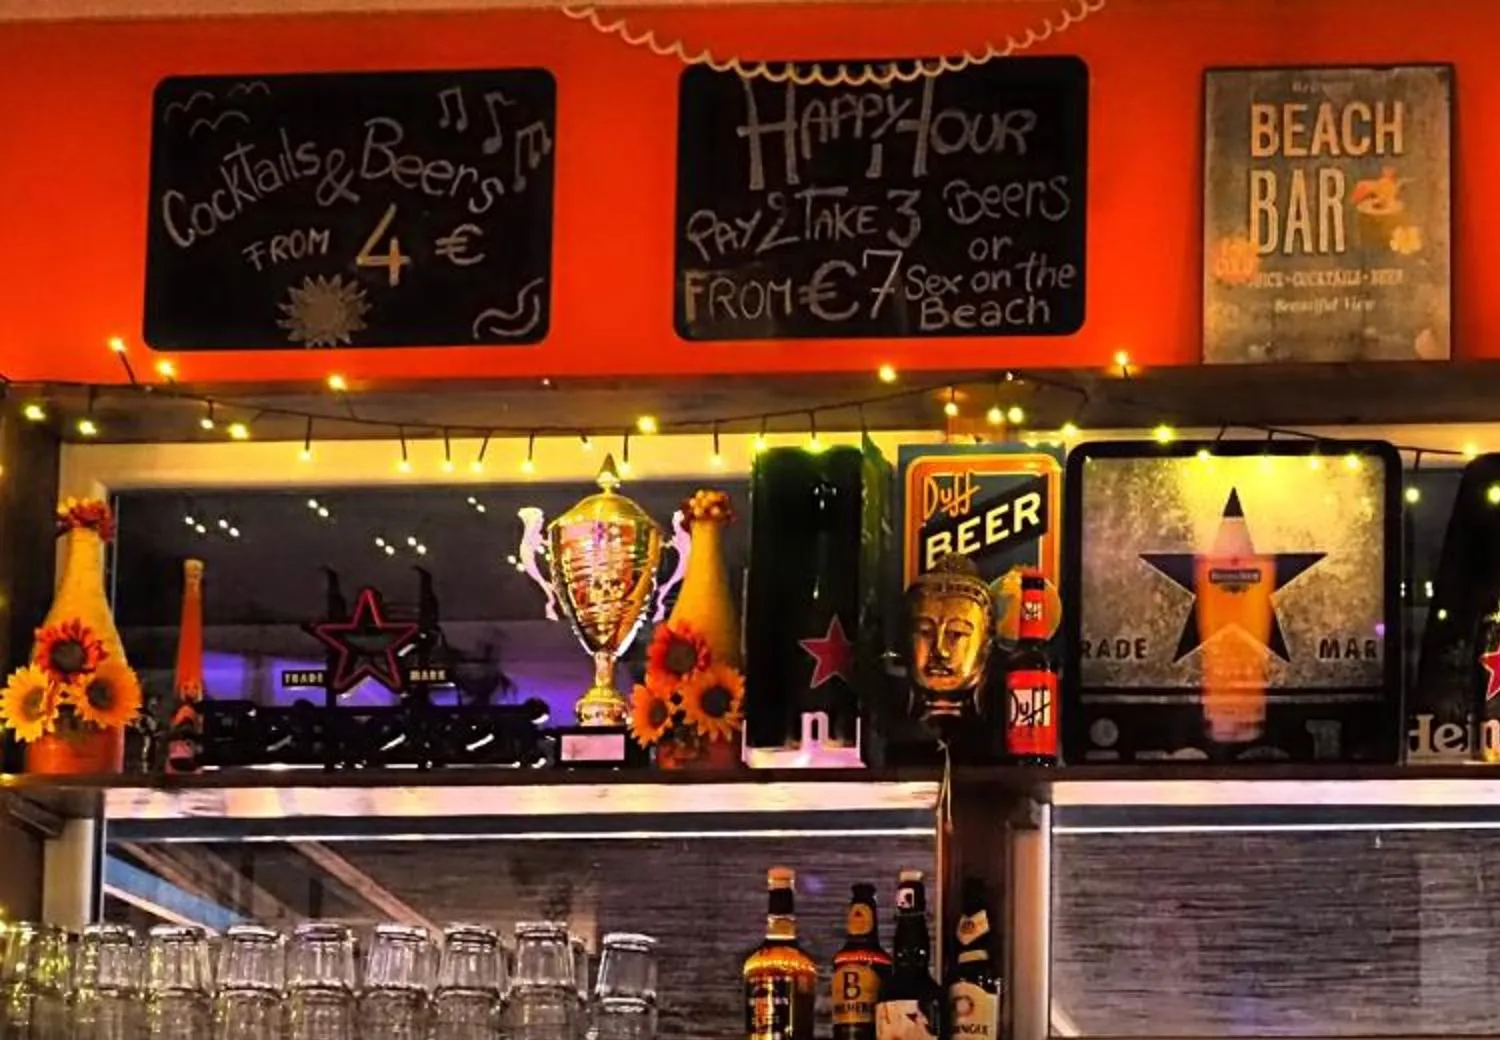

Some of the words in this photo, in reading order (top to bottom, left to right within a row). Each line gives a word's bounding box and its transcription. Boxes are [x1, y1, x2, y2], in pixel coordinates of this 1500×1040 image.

[899, 66, 1037, 177] HOUR
[1251, 101, 1404, 156] BEACH
[162, 128, 321, 248] Cocktails
[316, 149, 361, 207] &
[360, 117, 505, 214] Beers
[686, 209, 763, 262] PAY
[795, 186, 879, 240] TAKE
[886, 189, 922, 248] 3
[943, 175, 1071, 225] Beers
[1250, 168, 1345, 254] BAR
[242, 227, 331, 272] FROM
[355, 203, 412, 288] 4
[434, 223, 486, 266] €
[968, 235, 1013, 262] or
[685, 270, 793, 322] FROM
[904, 265, 963, 300] Sex
[970, 269, 1011, 293] on
[1017, 252, 1077, 290] the
[918, 297, 1052, 331] Beach
[923, 469, 981, 521] Duff
[926, 491, 1042, 571] BEER
[1080, 637, 1149, 660] RADE
[1318, 638, 1378, 660] MAR
[1009, 686, 1051, 729] Duff
